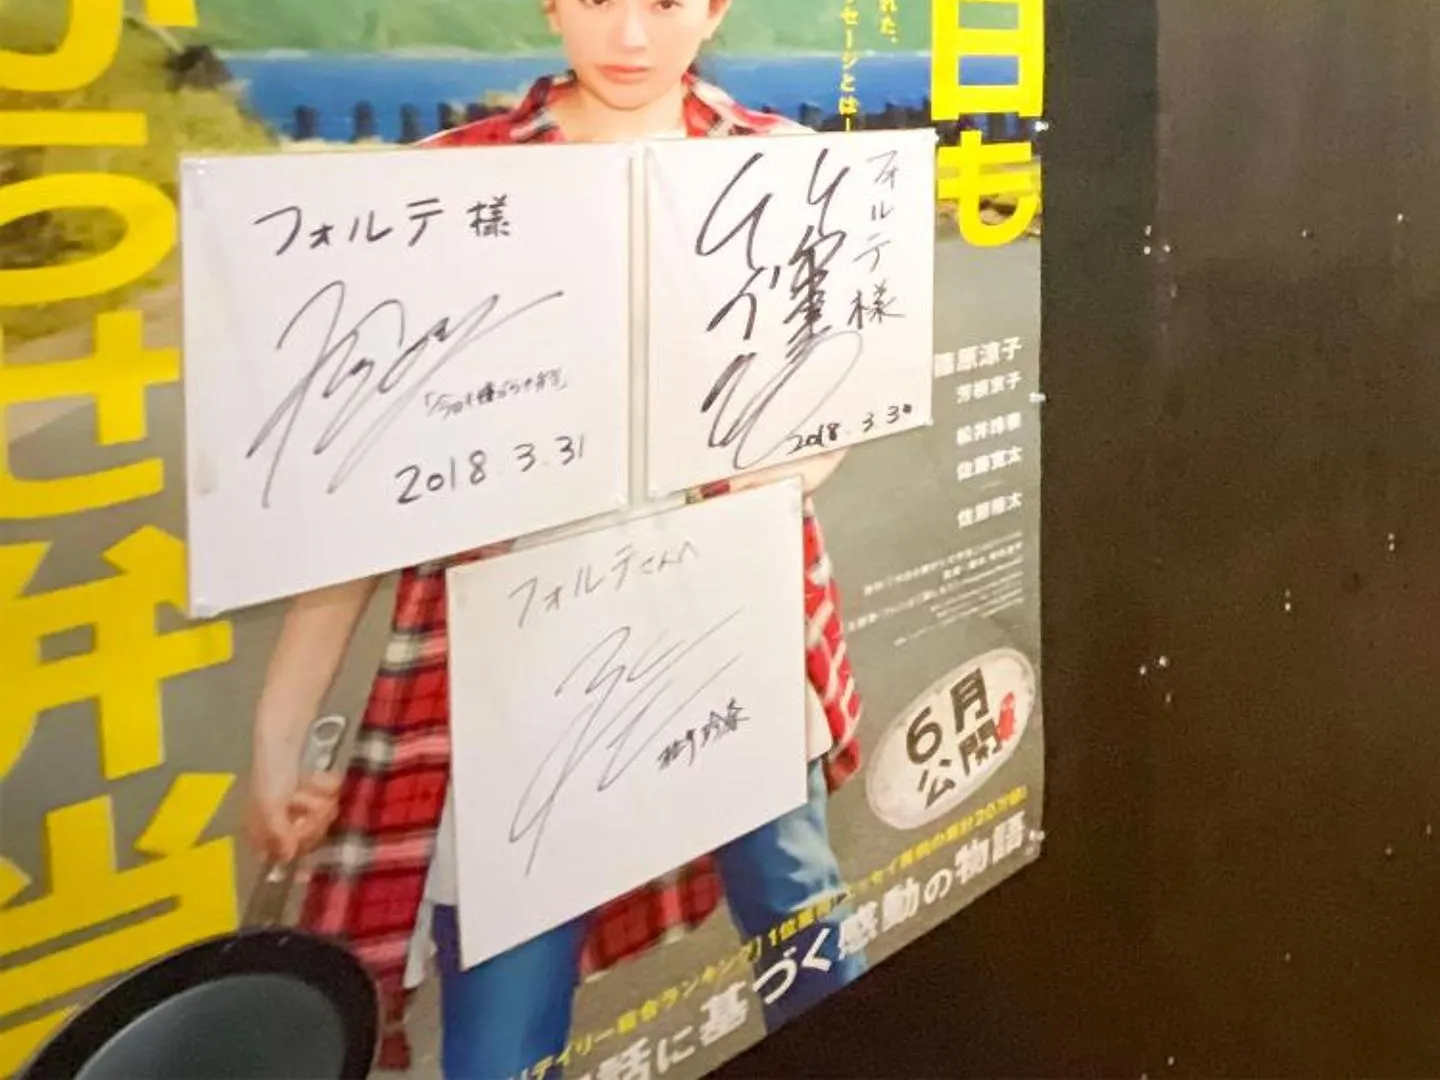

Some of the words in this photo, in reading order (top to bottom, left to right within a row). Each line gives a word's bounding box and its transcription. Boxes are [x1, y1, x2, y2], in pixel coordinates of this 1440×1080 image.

[253, 193, 511, 257] フォルテ様
[905, 667, 990, 766] 6月
[916, 717, 1003, 810] 公開
